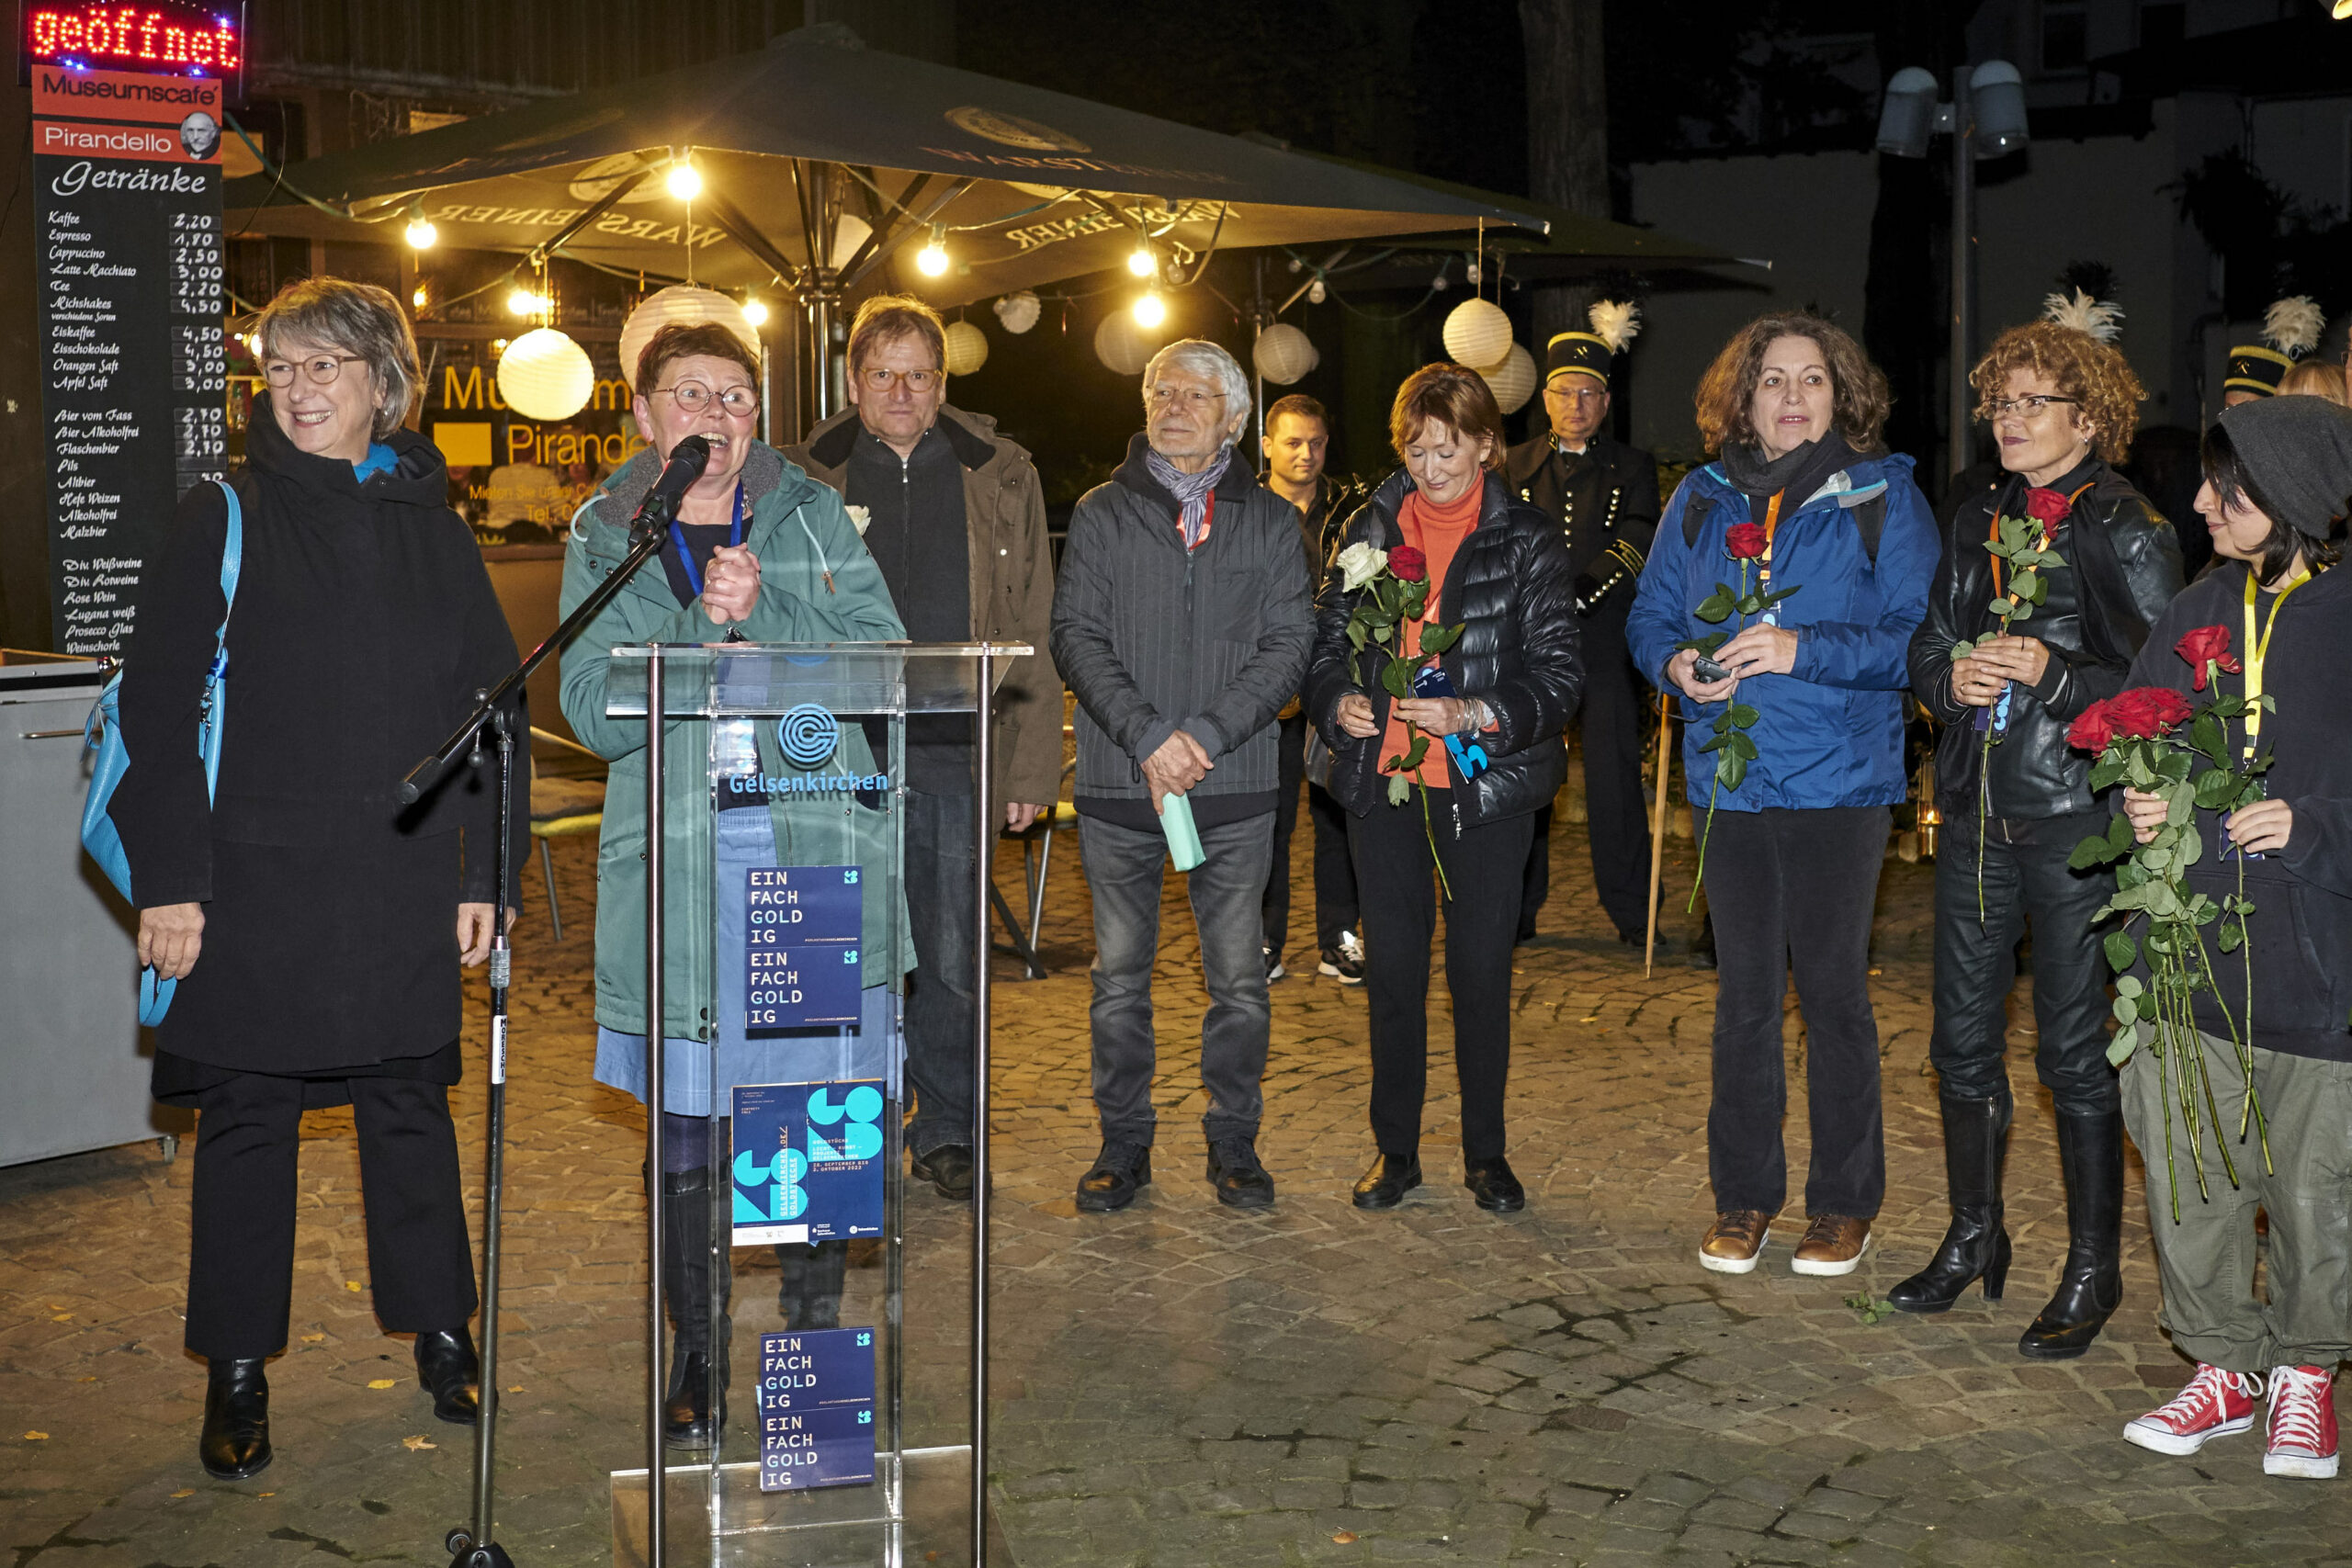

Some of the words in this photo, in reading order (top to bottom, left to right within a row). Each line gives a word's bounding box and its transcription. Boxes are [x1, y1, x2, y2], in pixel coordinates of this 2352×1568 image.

[34, 9, 239, 68] geöffnet
[43, 73, 219, 106] Museumscafé
[45, 127, 172, 153] Pirandello
[51, 161, 207, 197] Getränke
[48, 210, 80, 227] Kaffee
[175, 212, 212, 231] 2,20
[49, 230, 91, 244] Espresso
[175, 232, 213, 248] 1,80
[50, 246, 105, 262] Cappuccino
[175, 247, 219, 265] 2,50
[50, 263, 81, 275] Latte
[84, 263, 137, 277] Macchiato
[177, 264, 223, 281] 3,00
[50, 279, 70, 291] Tee
[178, 281, 221, 298] 2,20
[51, 311, 93, 321] verschiedene
[94, 311, 117, 322] Sorten
[52, 325, 96, 340] Eiskaffee
[183, 325, 222, 344] 4,50
[52, 343, 119, 355] Eisschokolade
[185, 343, 223, 361] 4,50
[53, 358, 96, 374] Orangen
[98, 359, 119, 374] Saft
[186, 359, 225, 378] 3,00
[53, 376, 85, 390] Apfel
[88, 377, 107, 389] Saft
[185, 377, 225, 394] 3,00
[54, 410, 79, 423] Bier
[82, 412, 102, 422] vom
[105, 409, 132, 423] Fass
[55, 426, 79, 439] Bier
[82, 426, 140, 441] Alkoholfrei
[56, 443, 119, 456] Flaschenbier
[57, 460, 78, 473] Pils
[58, 477, 96, 489] Altbier
[60, 492, 85, 506] Hefe
[88, 493, 120, 505] Weizen
[60, 510, 118, 525] Alkoholfrei
[60, 526, 107, 539] Malzbier
[62, 559, 89, 571] Div.
[93, 558, 142, 573] Weißweine
[63, 577, 89, 588] Div.
[93, 575, 139, 587] Rotweine
[63, 592, 90, 605] Rose
[94, 592, 117, 604] Wein
[65, 608, 109, 623] Lugana
[113, 606, 135, 620] weiß
[65, 625, 107, 639] Prosecco
[108, 624, 134, 638] Glas
[66, 639, 120, 654] Weinschorle
[729, 770, 888, 795] Gelsenkirchen
[752, 872, 787, 886] EIN
[751, 890, 798, 905] FACH
[751, 910, 803, 924] GOLD
[752, 930, 776, 943] IG
[752, 953, 787, 966] EIN
[751, 971, 798, 986] FACH
[751, 990, 803, 1004] GOLD
[752, 1010, 776, 1023] IG
[765, 1337, 801, 1353] EIN
[765, 1355, 812, 1371] FACH
[765, 1374, 817, 1390] GOLD
[766, 1394, 791, 1408] IG
[766, 1416, 802, 1432] EIN
[766, 1433, 813, 1450] FACH
[766, 1451, 818, 1468] GOLD
[768, 1472, 792, 1486] IG
